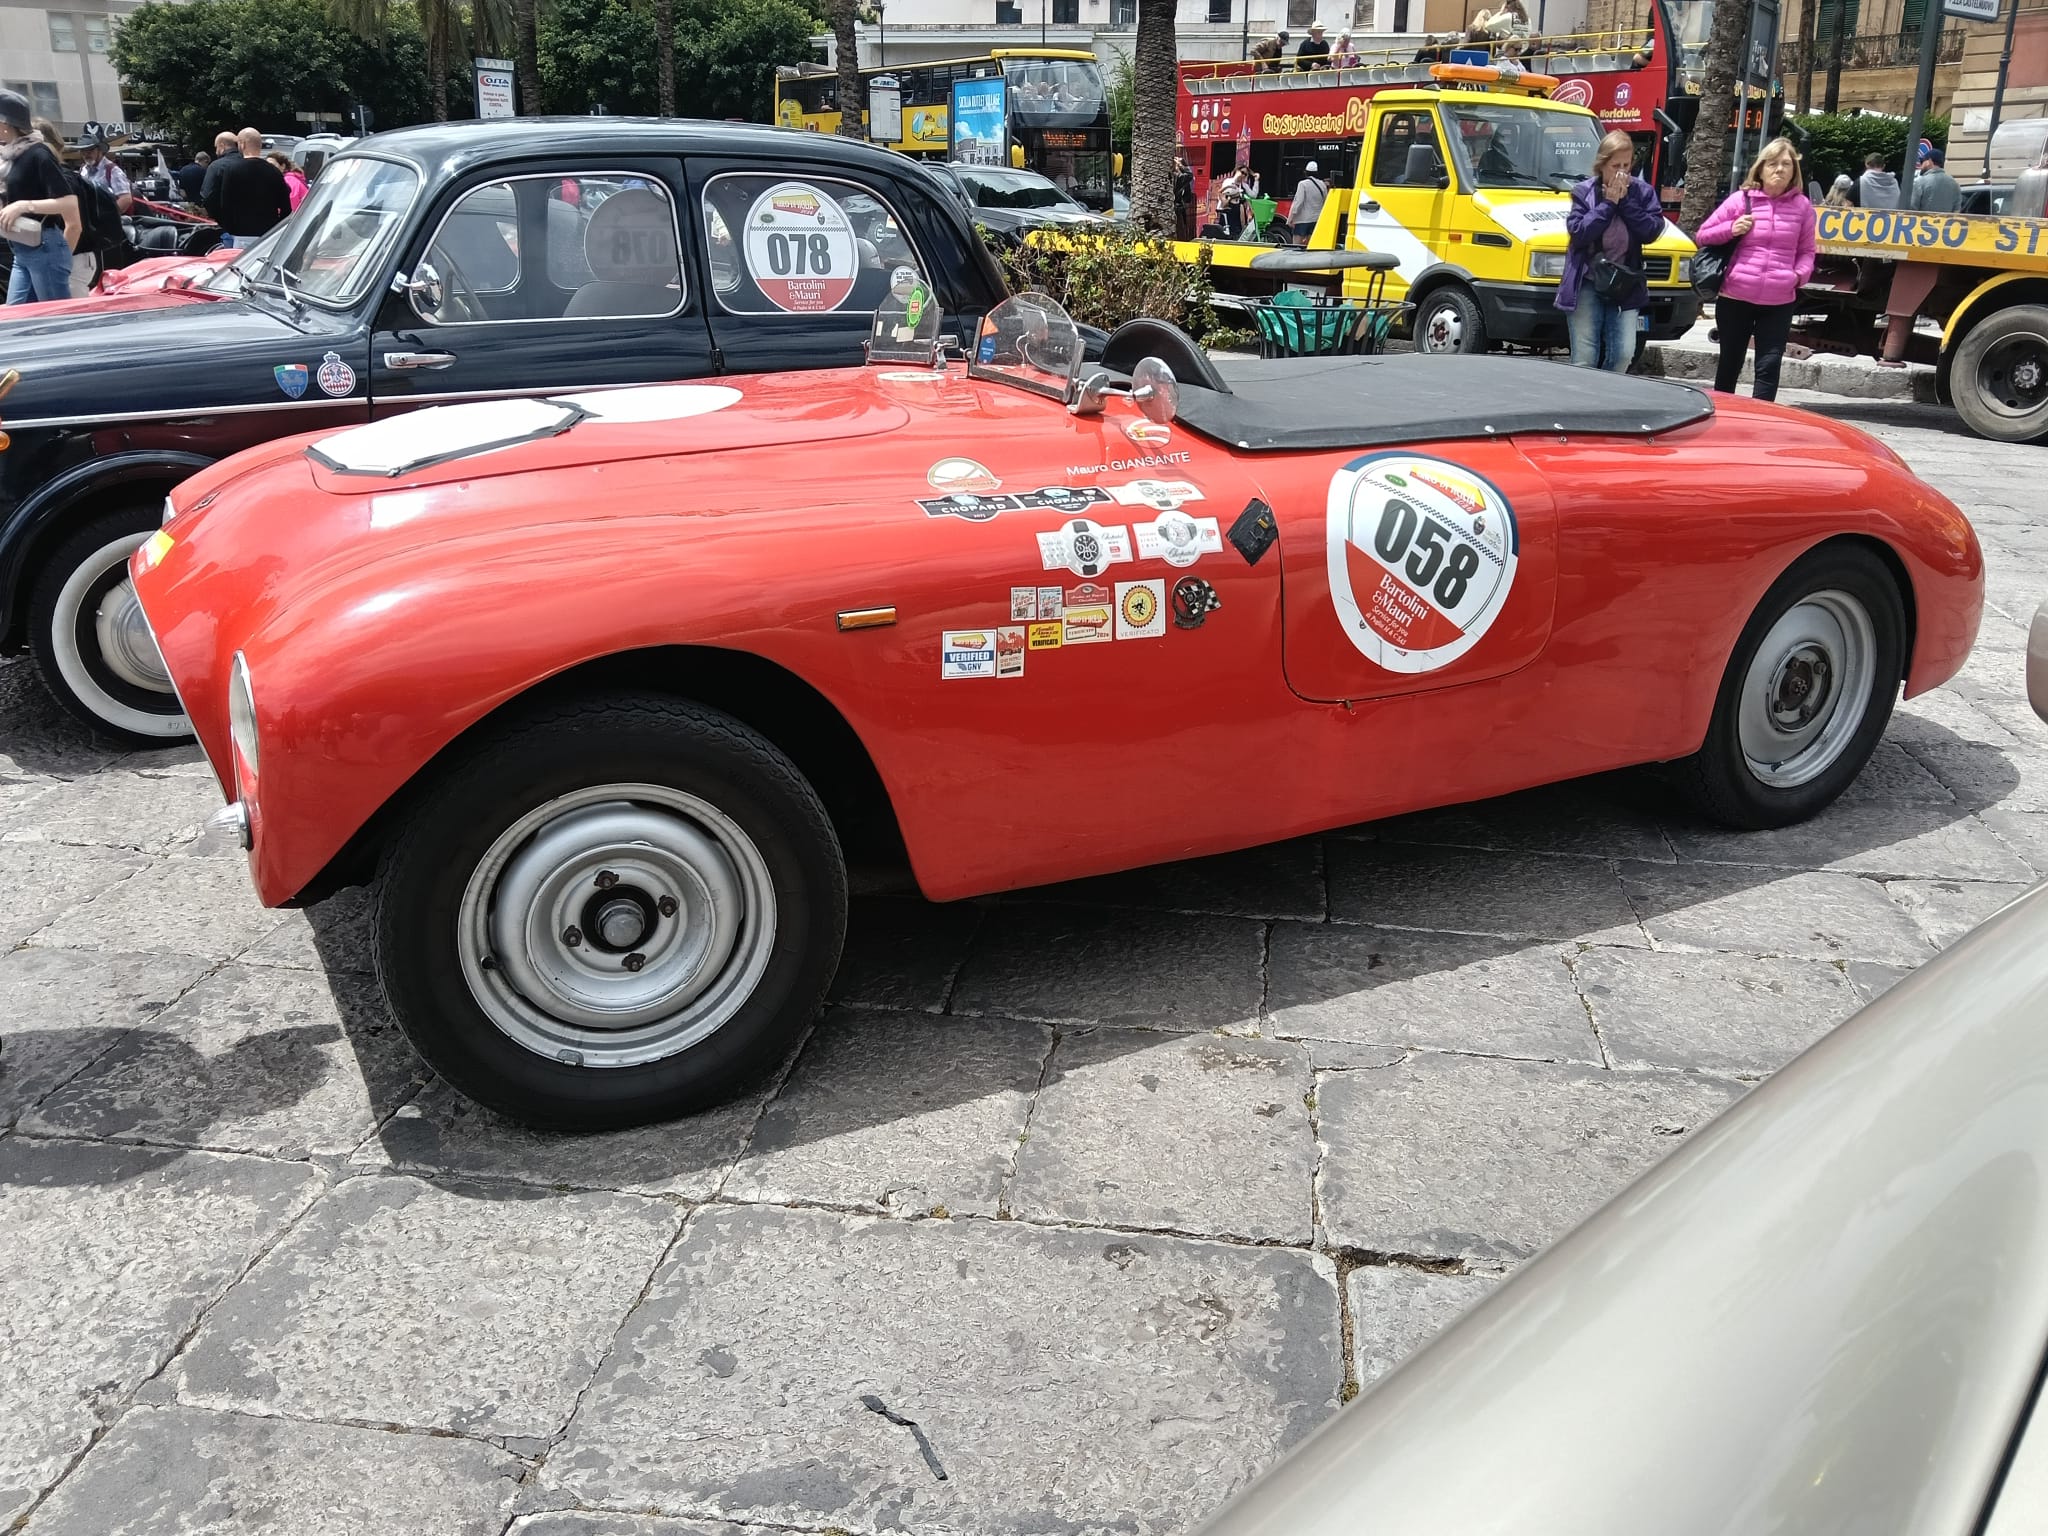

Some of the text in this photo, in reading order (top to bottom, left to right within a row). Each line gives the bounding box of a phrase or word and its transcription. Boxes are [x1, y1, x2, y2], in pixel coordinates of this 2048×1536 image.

[484, 60, 508, 68] TAXI
[480, 75, 509, 87] COSTA
[1262, 112, 1345, 136] CitySightseeing
[1524, 211, 1560, 222] CARRO
[1814, 209, 2048, 254] CCORSO ST
[767, 233, 831, 275] 078
[787, 280, 826, 290] Bartolini
[1066, 451, 1191, 477] Mauro GIANSANTE
[941, 503, 1006, 513] CHOPARD
[1038, 496, 1096, 506] CHOPARD
[1374, 498, 1479, 609] 058
[1380, 574, 1430, 620] Bartolini
[1372, 591, 1414, 627] &Mauri
[1372, 605, 1408, 637] Service for you
[1120, 629, 1159, 638] VERIFICATO
[950, 652, 990, 662] VERIFIED
